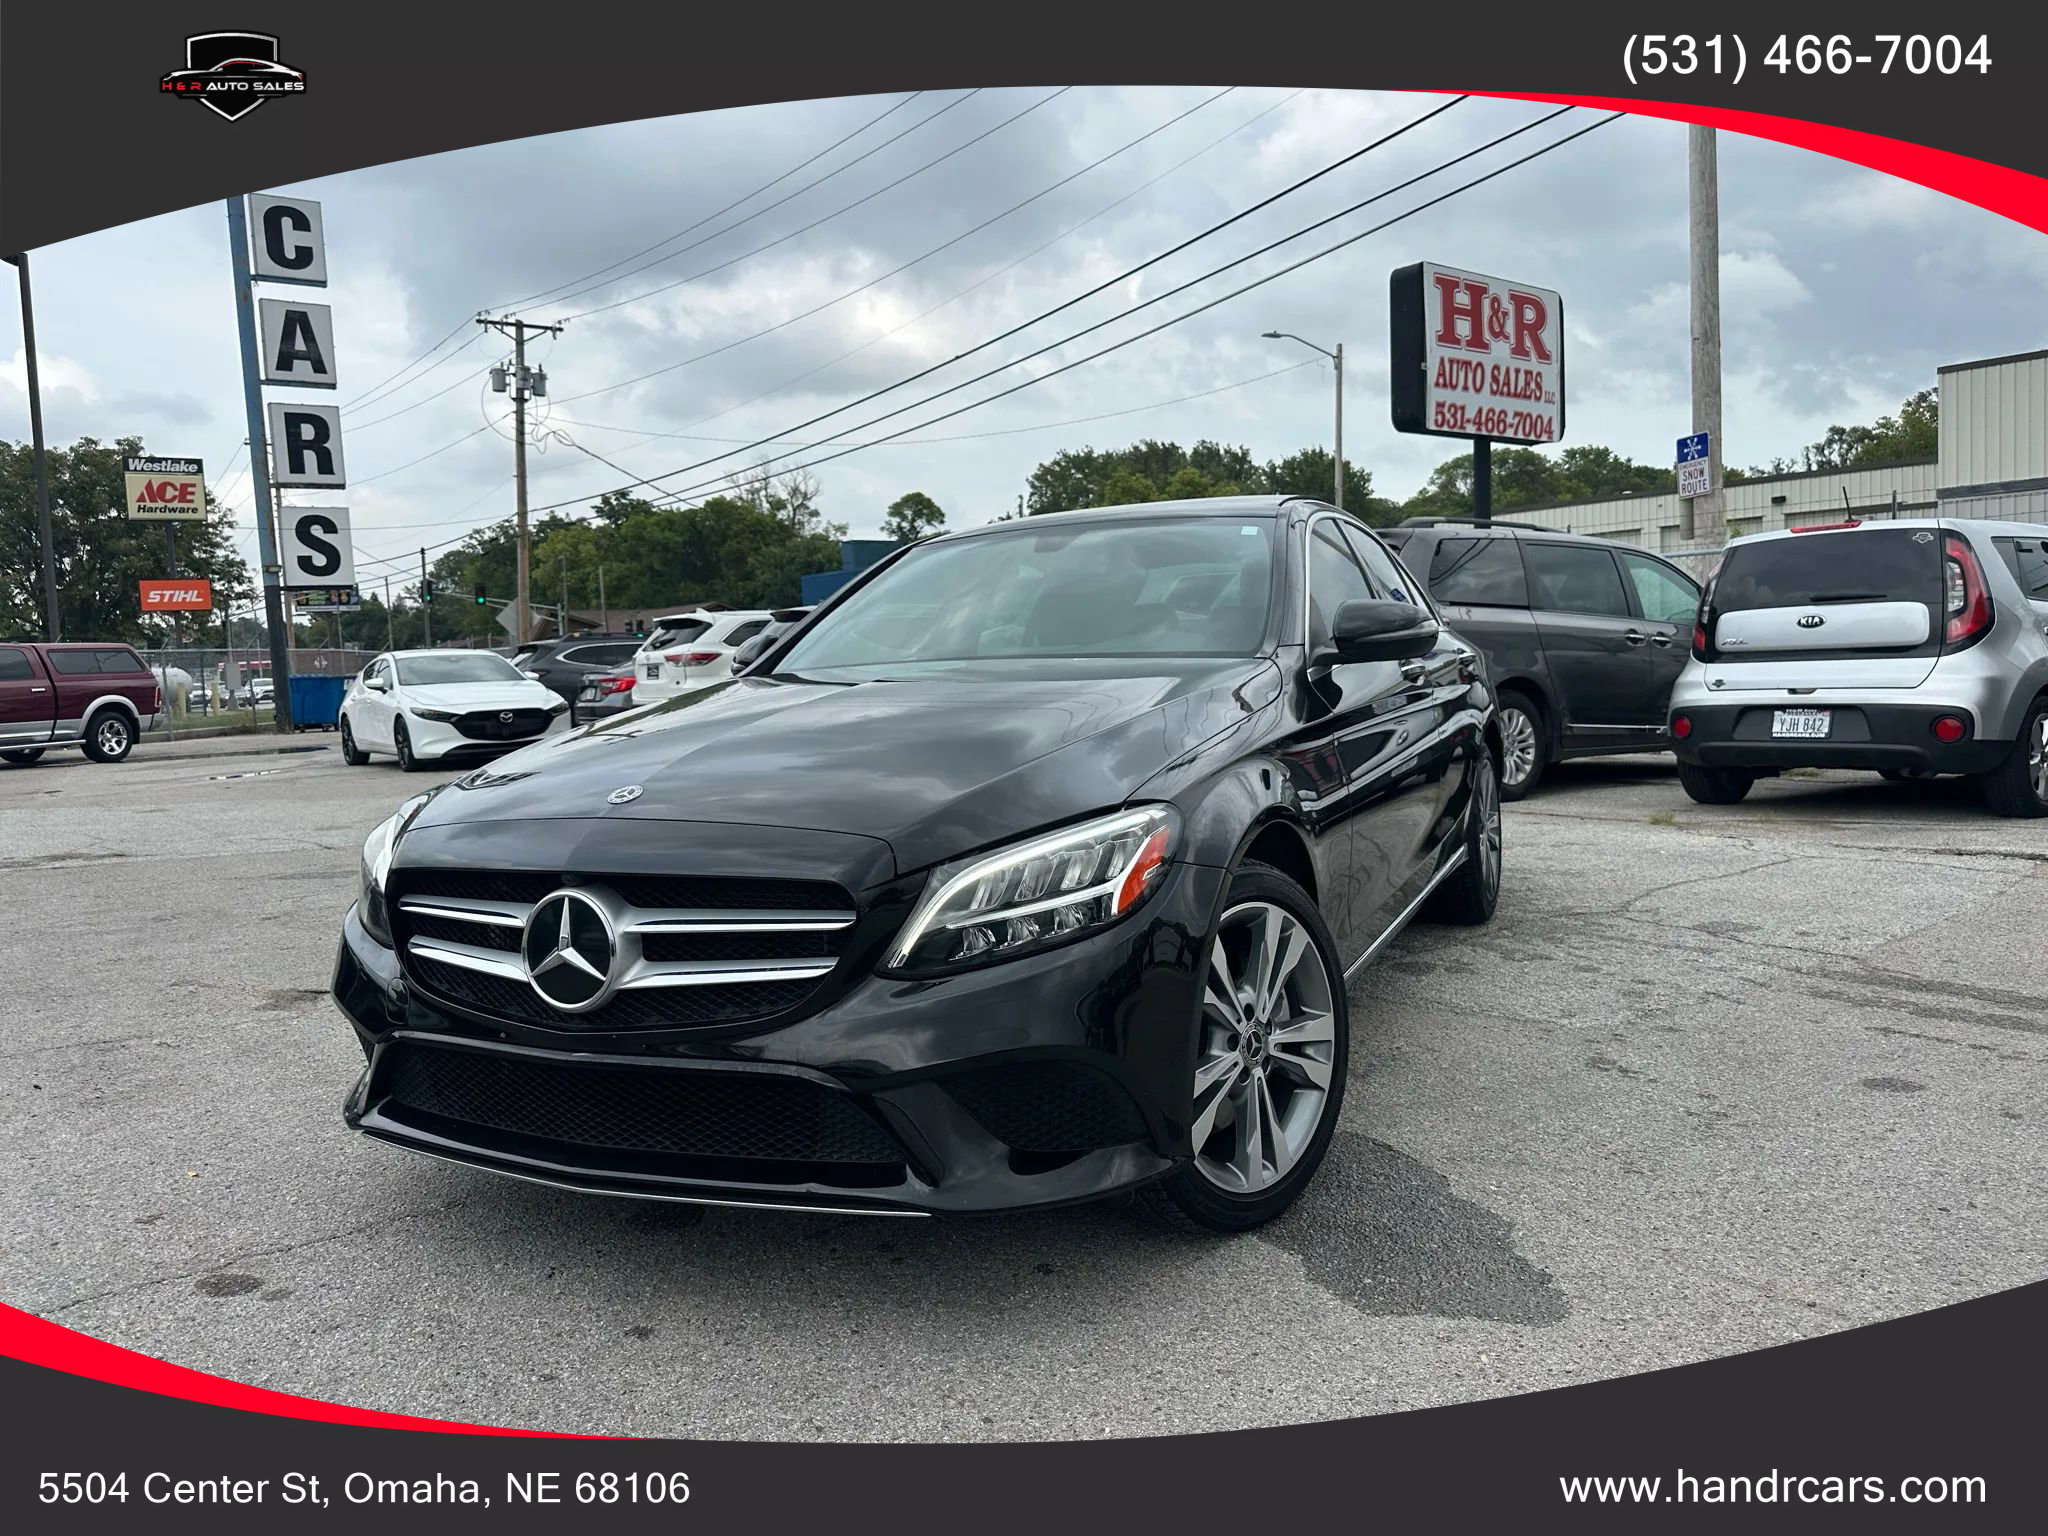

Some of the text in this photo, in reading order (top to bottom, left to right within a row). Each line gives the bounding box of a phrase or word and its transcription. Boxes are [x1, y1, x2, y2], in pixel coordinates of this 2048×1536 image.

[1433, 272, 1552, 365] H&R
[1434, 356, 1556, 405] AUTO SALES LLC
[1434, 400, 1554, 440] 531-466-7004
[128, 458, 198, 473] Westlake
[1682, 466, 1705, 481] SNOW
[136, 479, 196, 504] ACE
[1681, 479, 1707, 495] ROUTE
[137, 504, 198, 514] Hardware
[147, 590, 203, 603] STIHL
[1800, 616, 1821, 626] KIA
[1780, 717, 1824, 732] YJH 842
